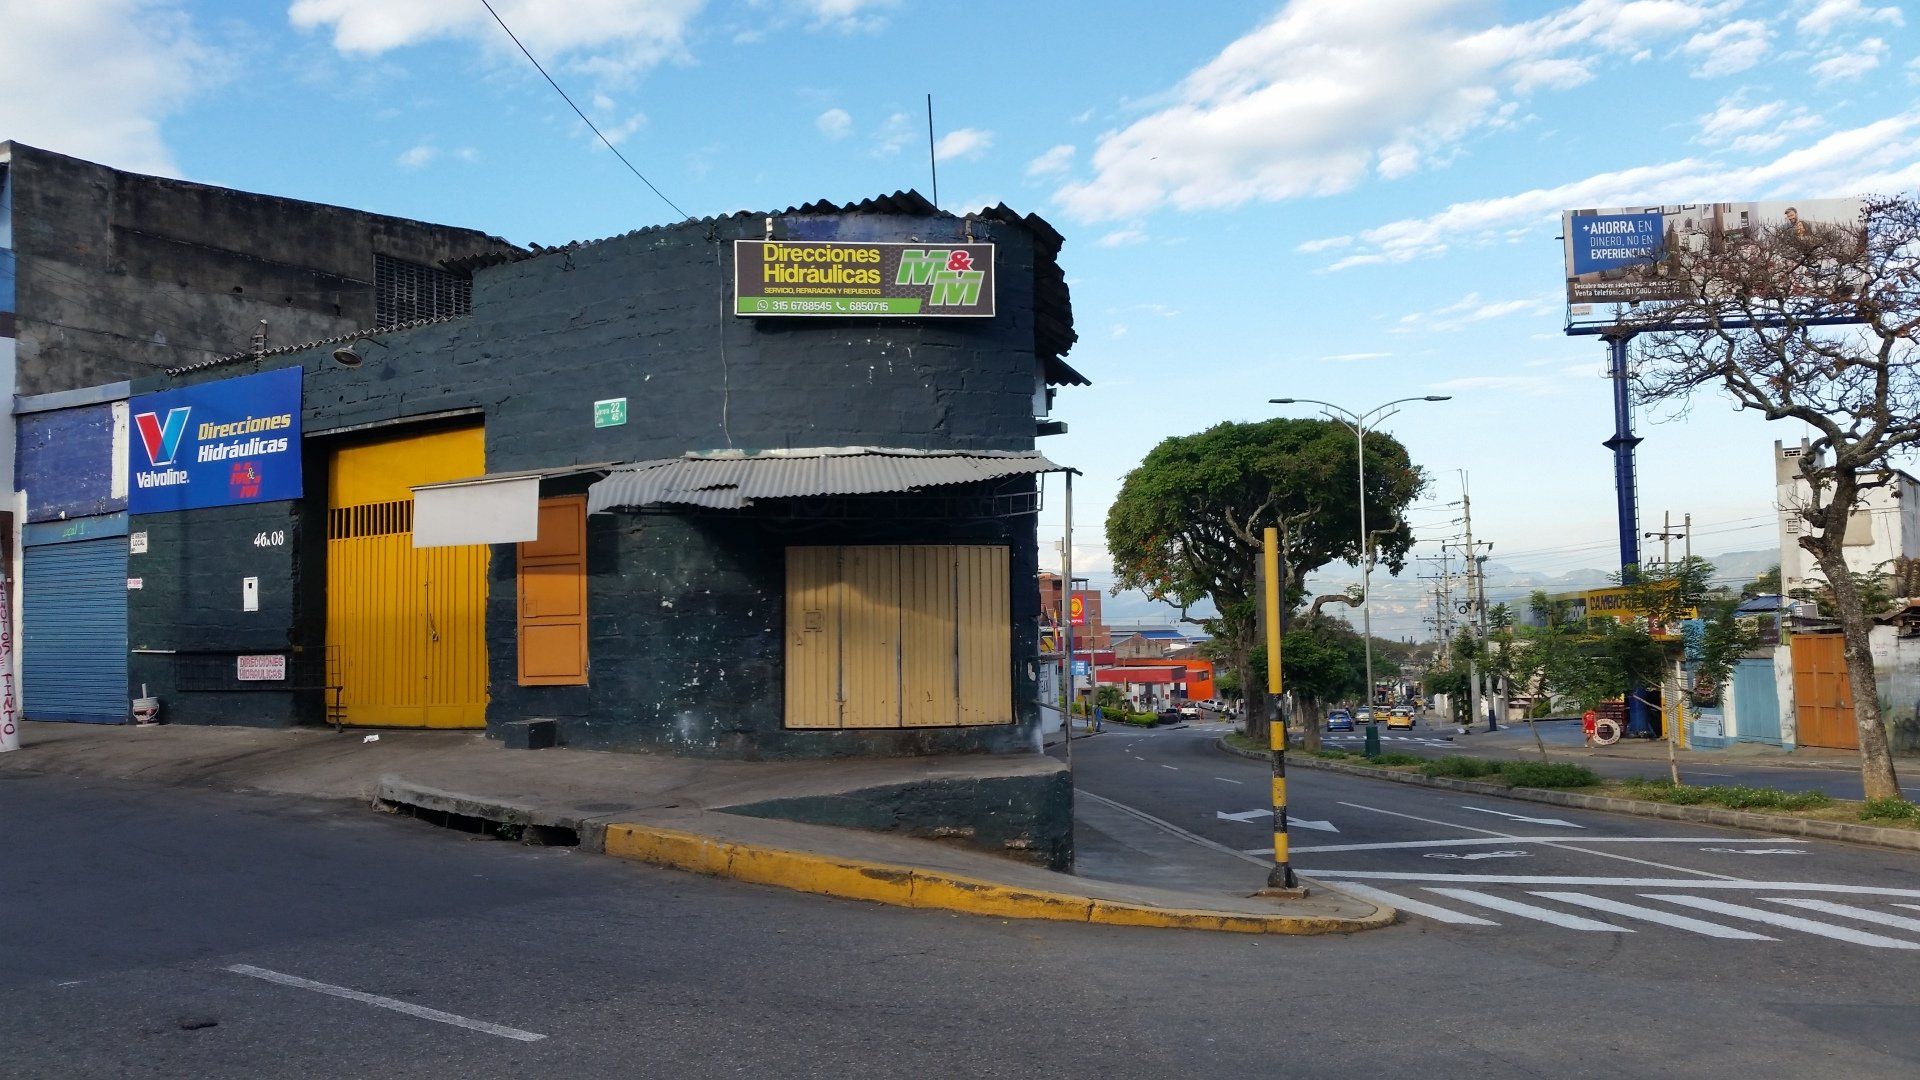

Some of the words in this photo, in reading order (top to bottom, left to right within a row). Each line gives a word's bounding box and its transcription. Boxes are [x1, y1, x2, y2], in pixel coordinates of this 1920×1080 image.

[1639, 220, 1653, 232] EN
[1591, 235, 1625, 247] DINERO,
[1627, 235, 1639, 246] NO
[1642, 234, 1654, 244] EN
[763, 243, 881, 263] Direcciones
[764, 263, 881, 284] Hidráulicas
[772, 301, 788, 310] 315
[790, 302, 832, 311] 6788545
[849, 302, 889, 311] 6850715
[611, 402, 620, 414] 22
[198, 414, 292, 440] Direcciones
[197, 437, 288, 463] Hidráulicas
[239, 657, 284, 667] DIRECCIONES
[2, 672, 15, 735] TINTO
